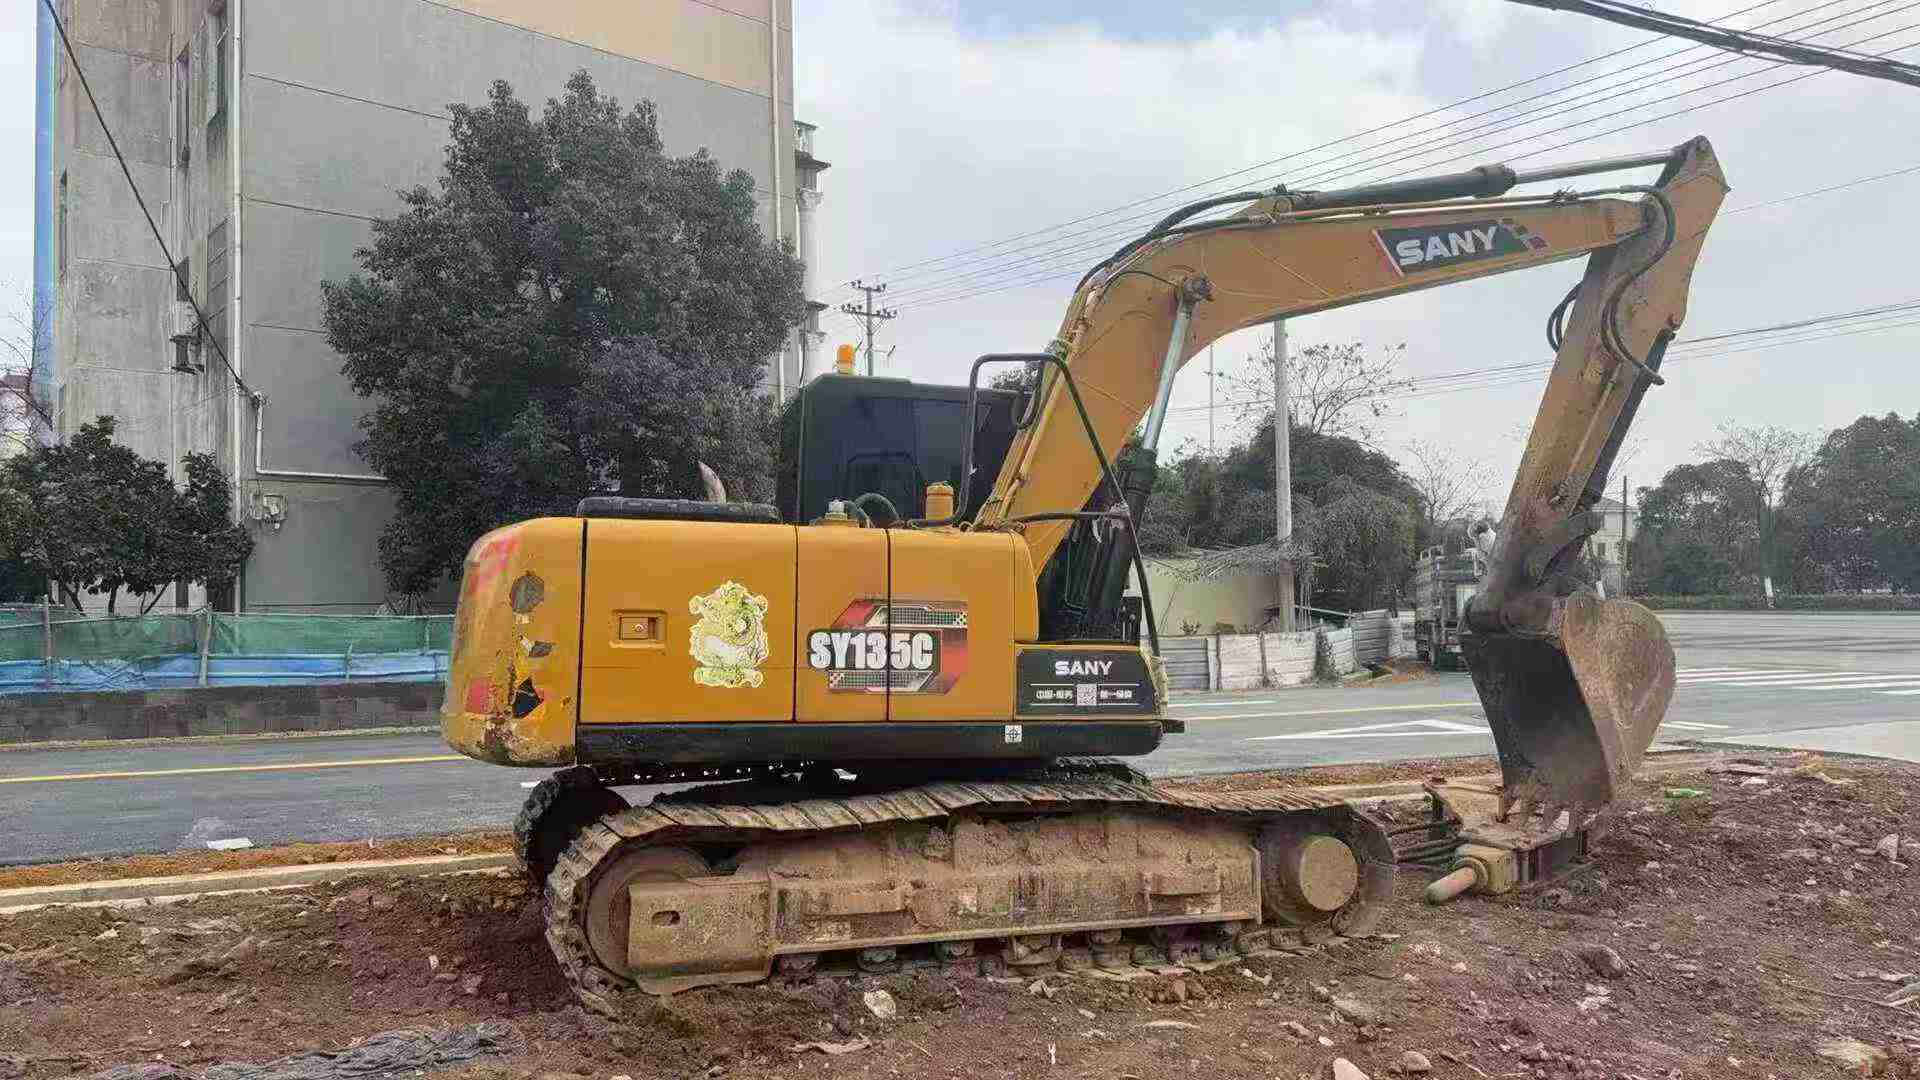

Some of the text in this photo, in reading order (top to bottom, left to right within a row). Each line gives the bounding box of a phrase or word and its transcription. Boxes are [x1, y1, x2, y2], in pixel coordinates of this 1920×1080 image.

[1396, 225, 1498, 266] SANY
[810, 631, 934, 671] SY135C
[1054, 660, 1113, 676] SANY
